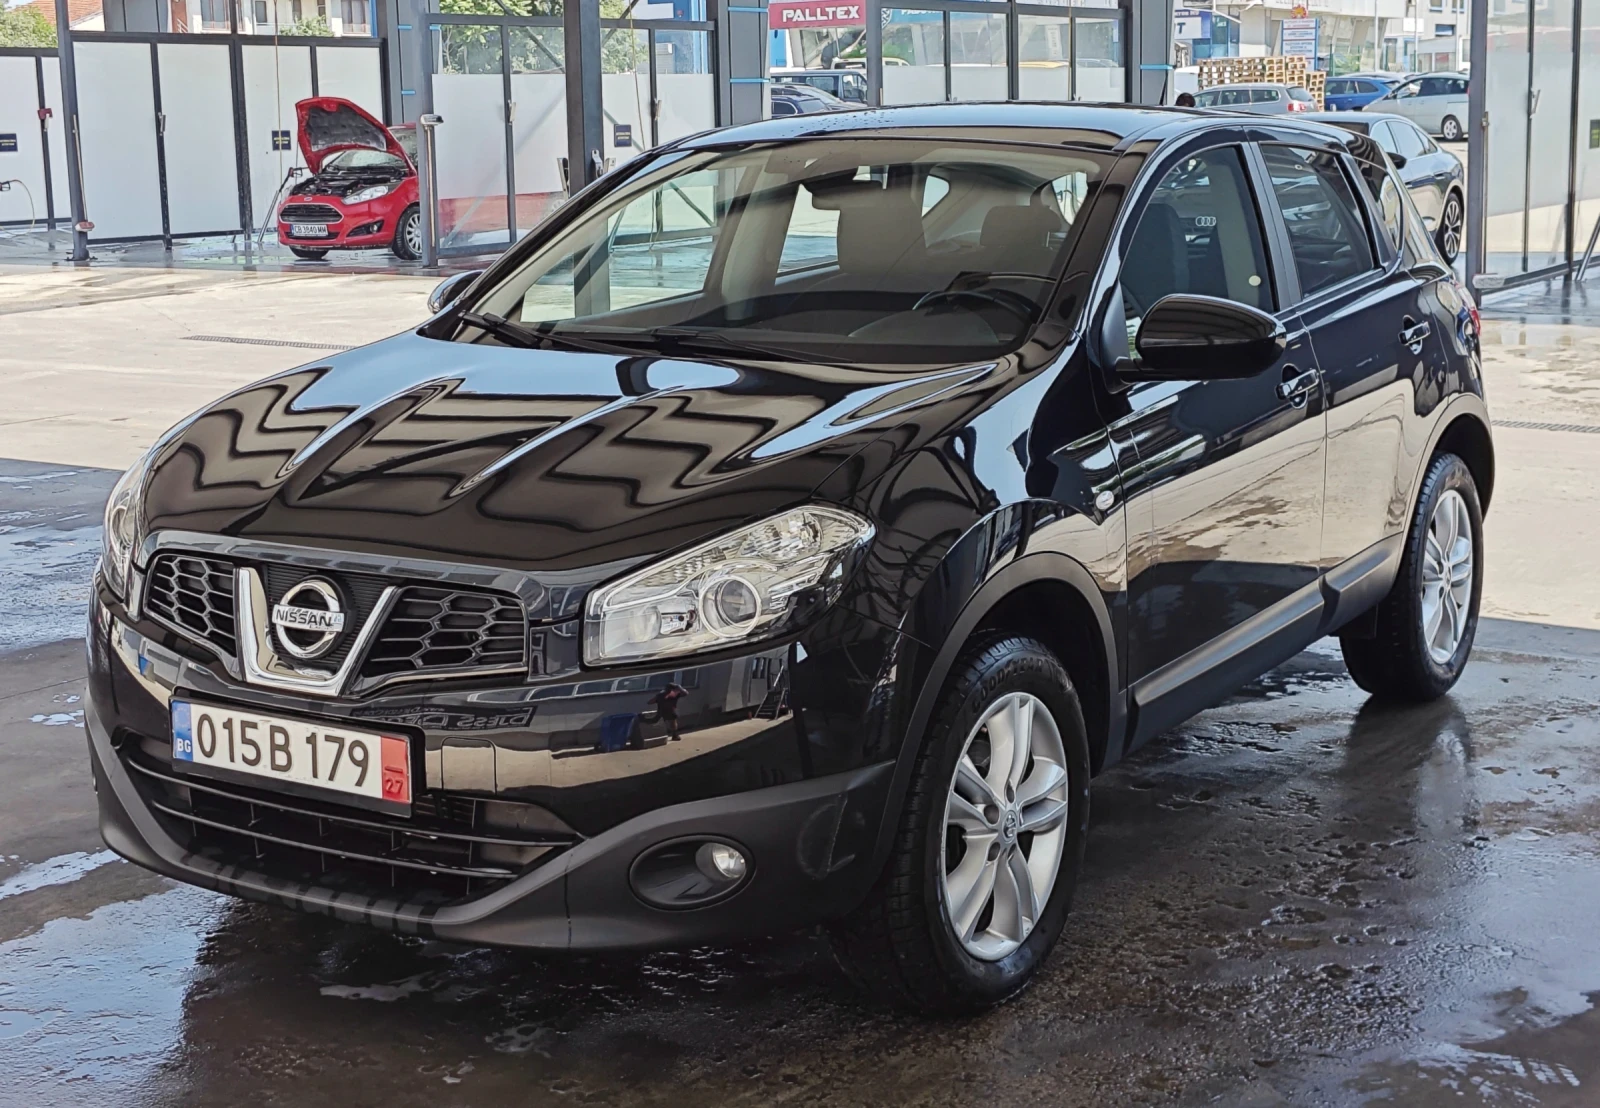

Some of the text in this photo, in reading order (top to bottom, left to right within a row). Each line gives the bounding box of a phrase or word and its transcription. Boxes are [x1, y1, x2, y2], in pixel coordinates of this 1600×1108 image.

[782, 6, 860, 22] PALLTEX
[275, 609, 333, 627] NISSAN
[177, 738, 192, 753] BG
[385, 778, 404, 794] 27
